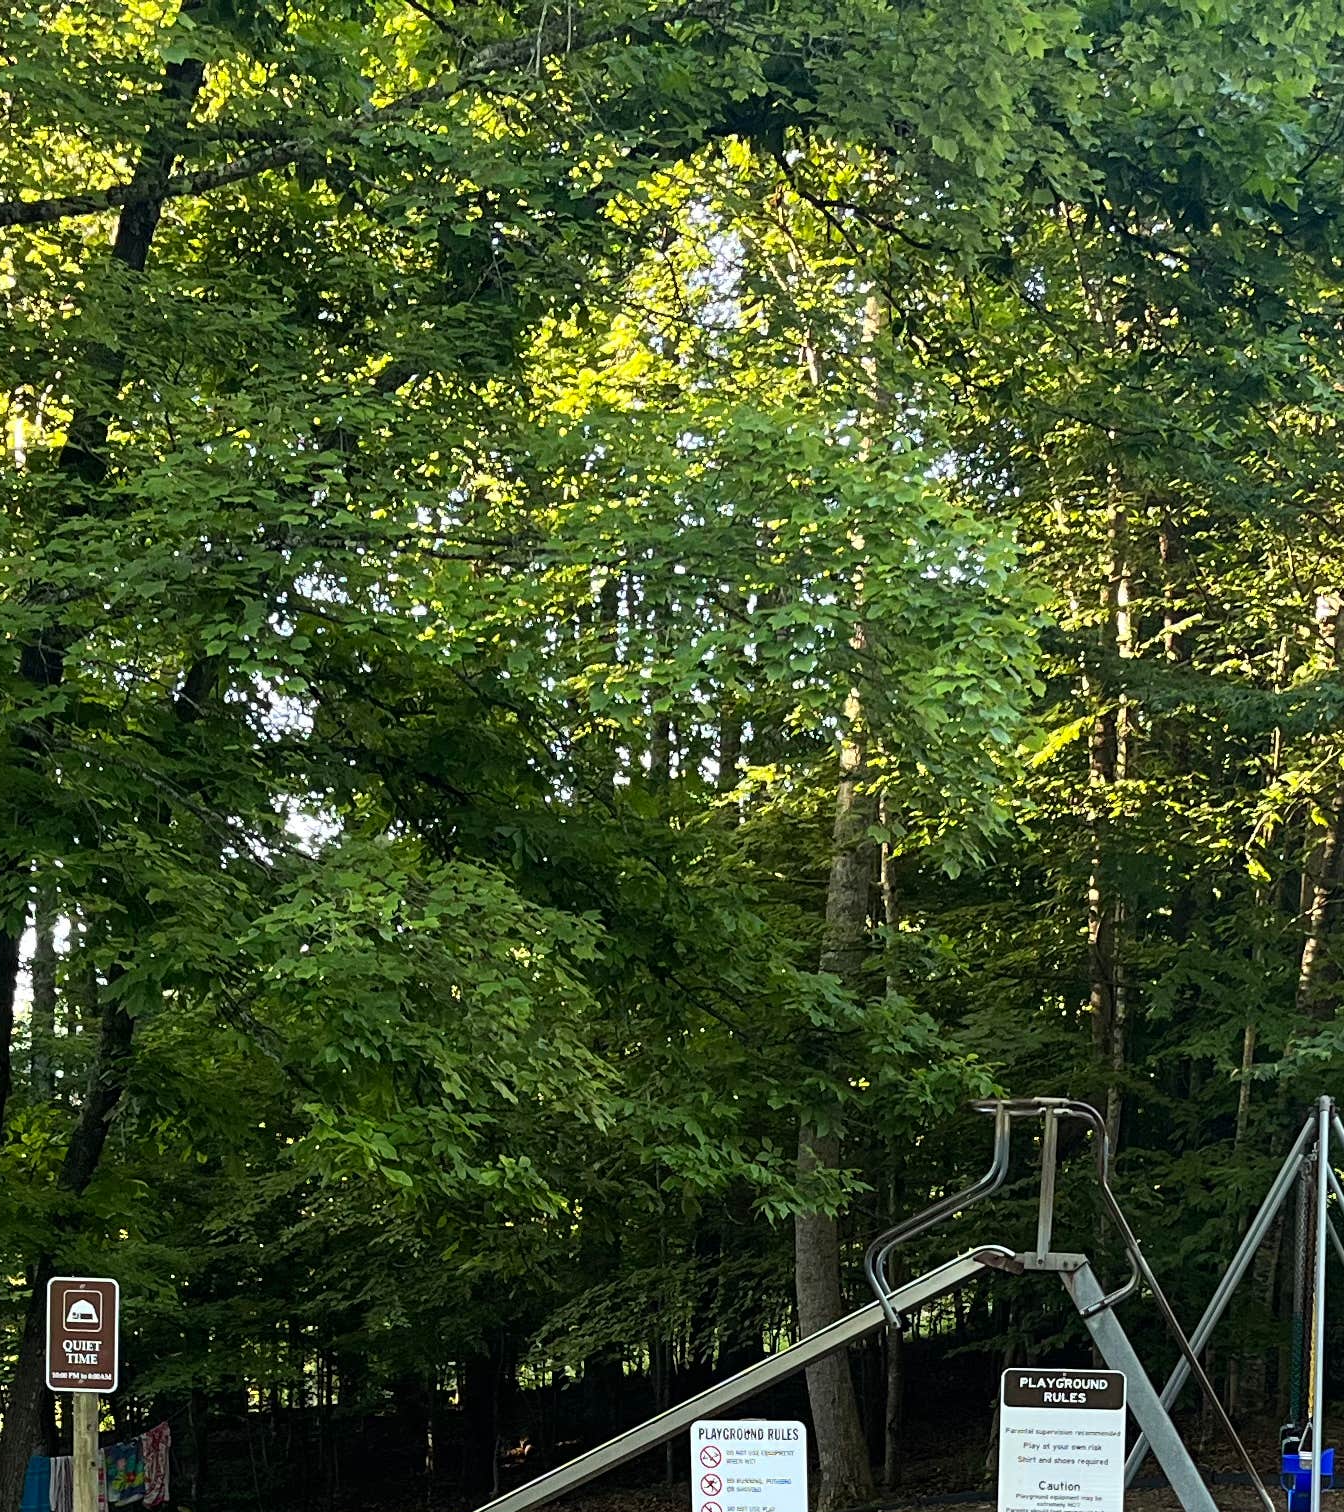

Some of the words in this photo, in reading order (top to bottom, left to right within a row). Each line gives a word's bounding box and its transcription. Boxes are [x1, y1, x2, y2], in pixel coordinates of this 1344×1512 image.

[62, 1340, 102, 1352] QUIET
[66, 1353, 98, 1364] TIME
[68, 1371, 80, 1379] PM
[1019, 1377, 1108, 1390] PLAYGROUND
[1043, 1392, 1087, 1403] RULES
[698, 1428, 764, 1440] PLAYGROUND
[768, 1428, 799, 1440] RULES
[1023, 1442, 1040, 1450] Play
[1017, 1455, 1036, 1463] Shirt
[1077, 1458, 1109, 1466] required
[1038, 1480, 1081, 1491] Caution
